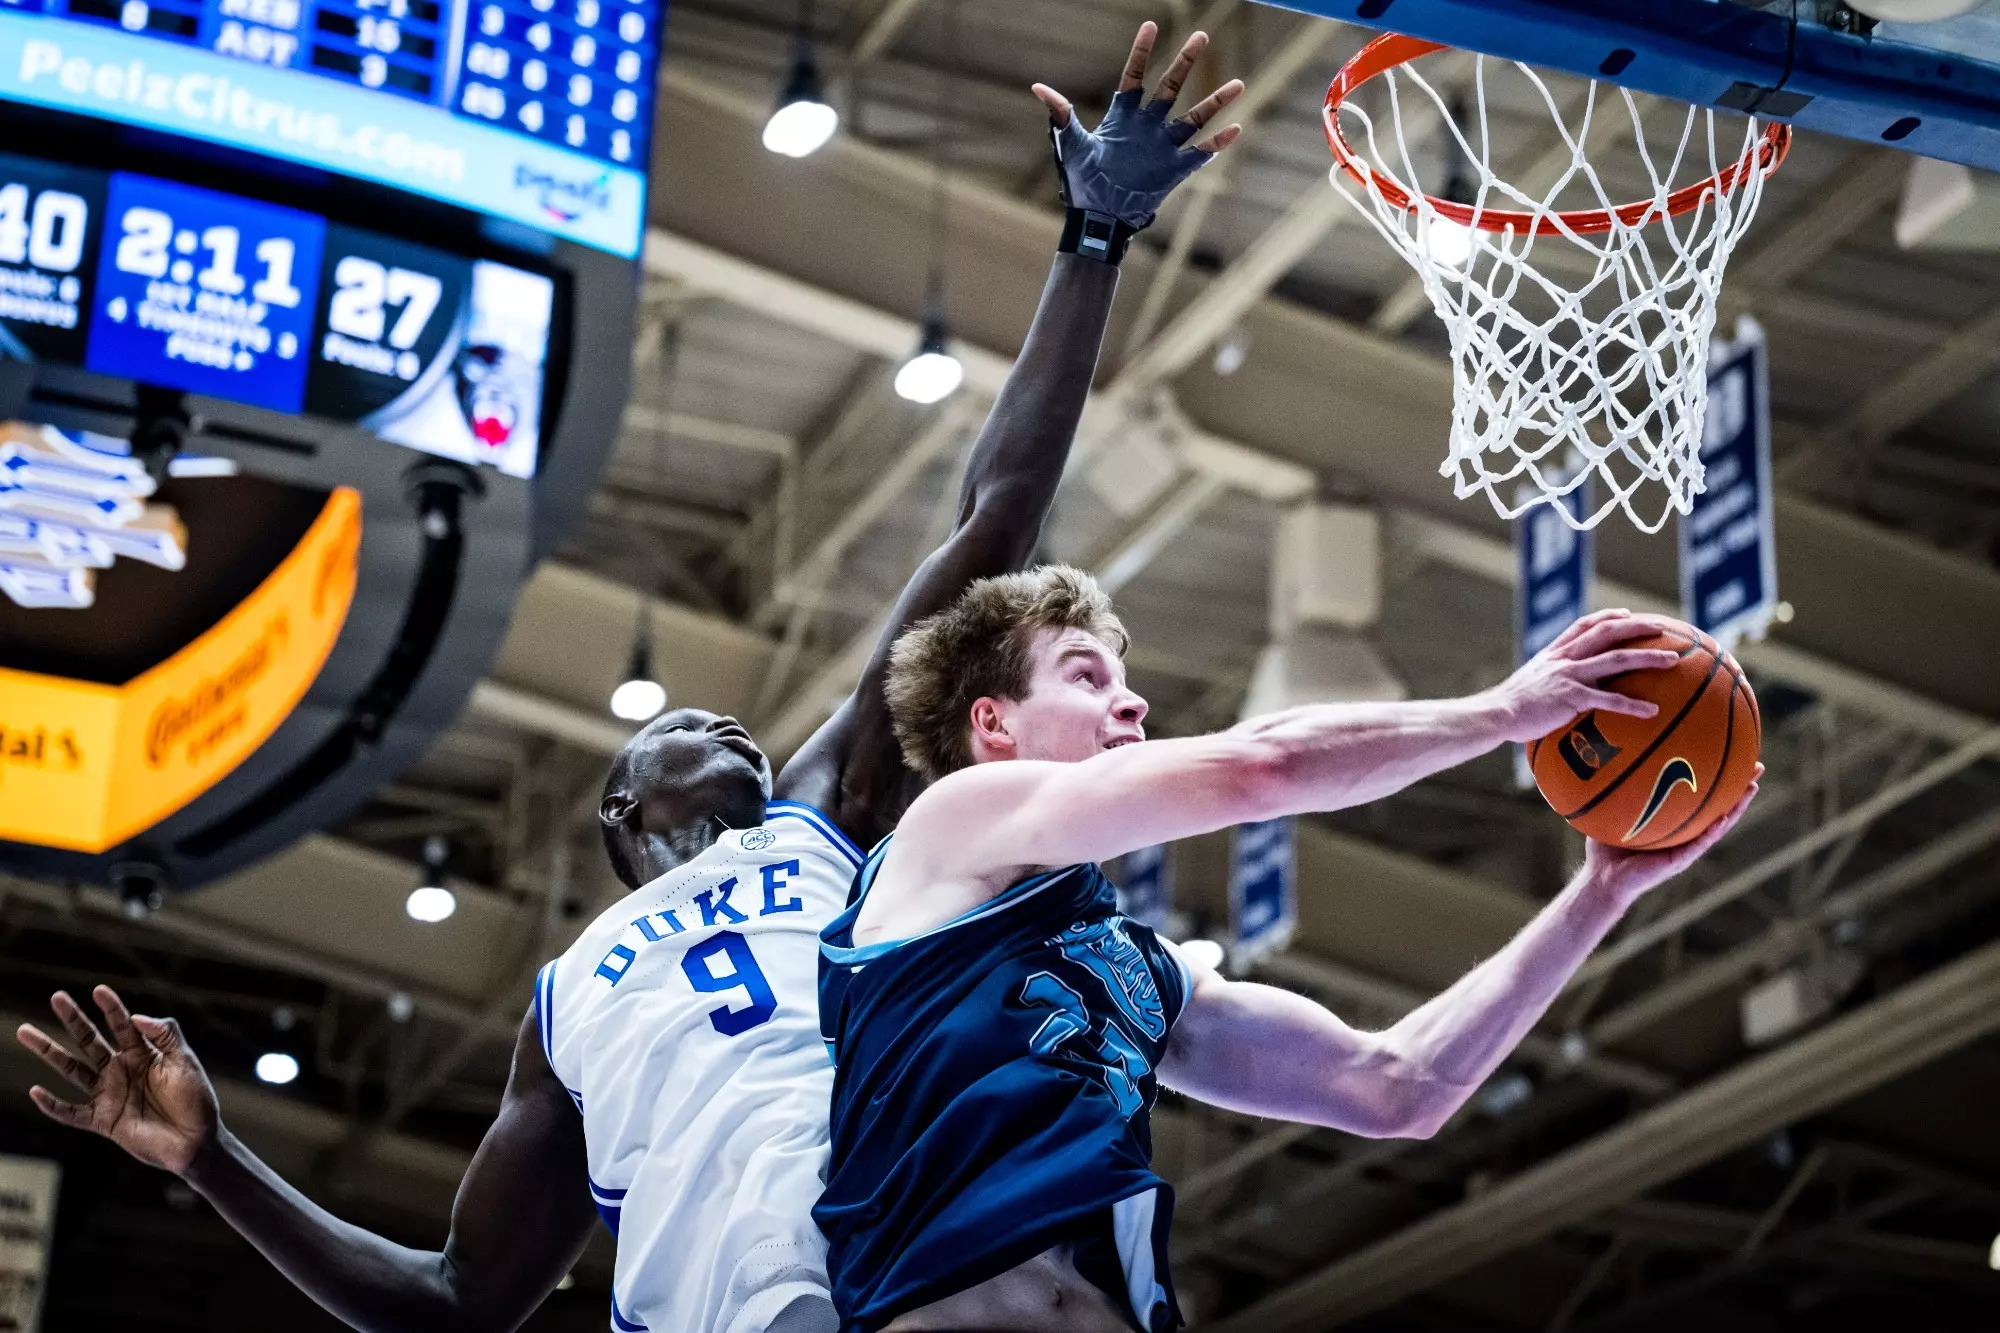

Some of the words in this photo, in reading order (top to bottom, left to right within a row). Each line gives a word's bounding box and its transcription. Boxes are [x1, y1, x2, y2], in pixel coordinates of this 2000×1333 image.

[19, 39, 466, 184] PeelzCitrus.com
[116, 206, 300, 309] 2:11
[329, 255, 442, 351] 27
[746, 832, 772, 844] ACC
[594, 859, 803, 988] DUKE
[680, 930, 778, 1037] 9
